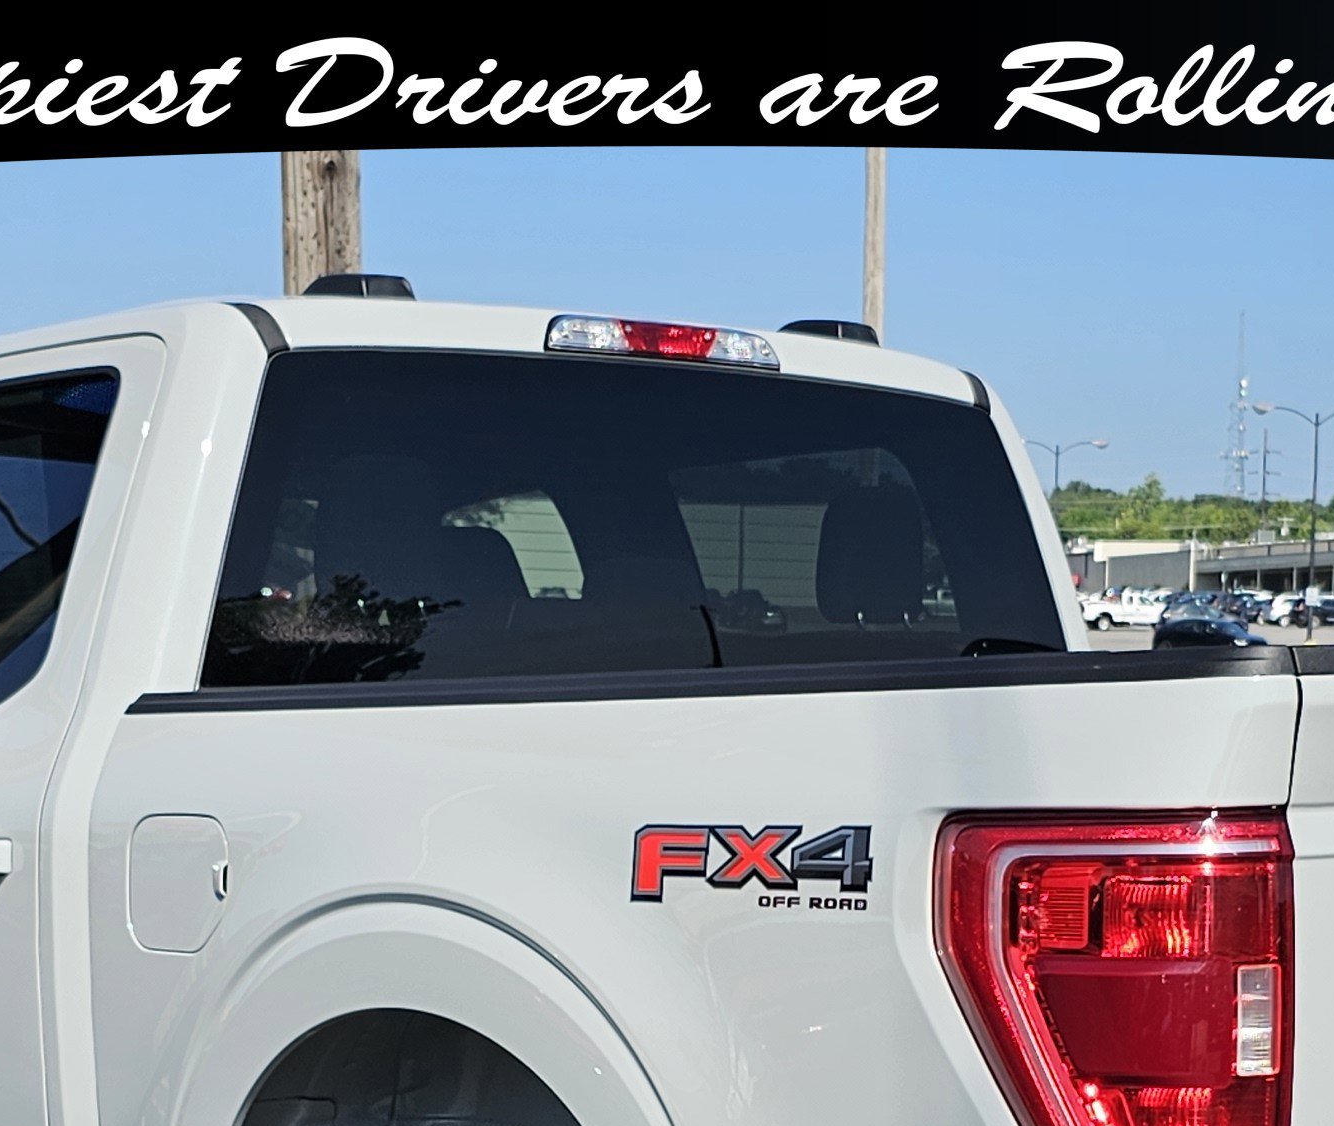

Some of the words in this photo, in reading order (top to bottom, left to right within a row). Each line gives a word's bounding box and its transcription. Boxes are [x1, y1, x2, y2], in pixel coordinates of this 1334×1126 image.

[629, 823, 873, 903] FX4
[757, 895, 801, 908] OFF
[808, 896, 868, 911] ROAD
